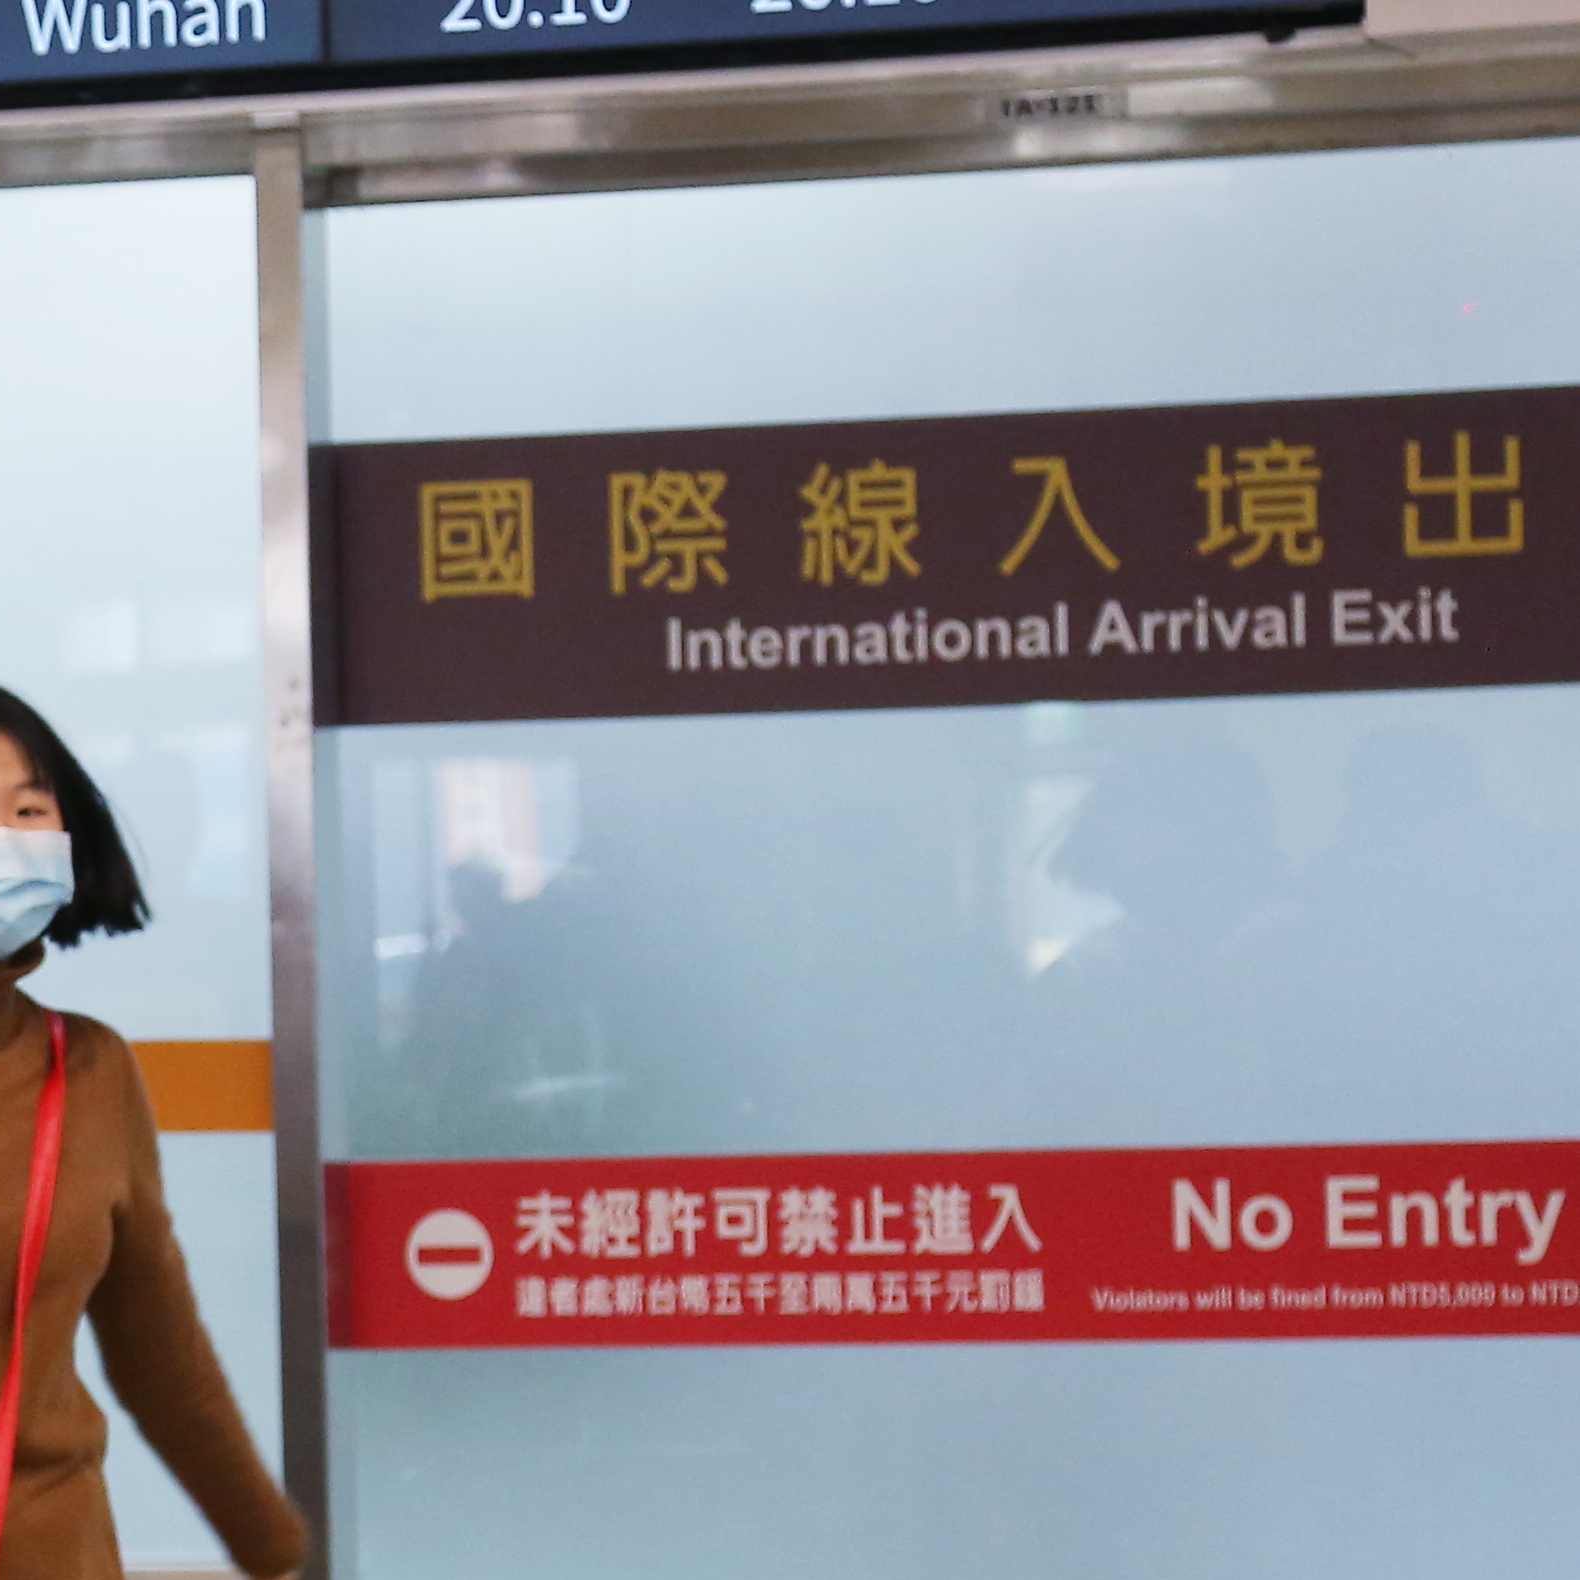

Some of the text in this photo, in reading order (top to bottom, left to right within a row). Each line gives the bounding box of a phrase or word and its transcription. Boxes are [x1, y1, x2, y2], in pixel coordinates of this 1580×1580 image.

[21, 0, 267, 55] Wuhan
[416, 428, 1525, 603] 國際線入境出
[667, 587, 1460, 672] International Arrival Exit
[516, 1184, 1042, 1259] 未經許可禁止進入
[1172, 1174, 1566, 1266] No Entry
[1195, 1286, 1233, 1310] will
[1330, 1283, 1385, 1309] from
[1500, 1284, 1526, 1308] to
